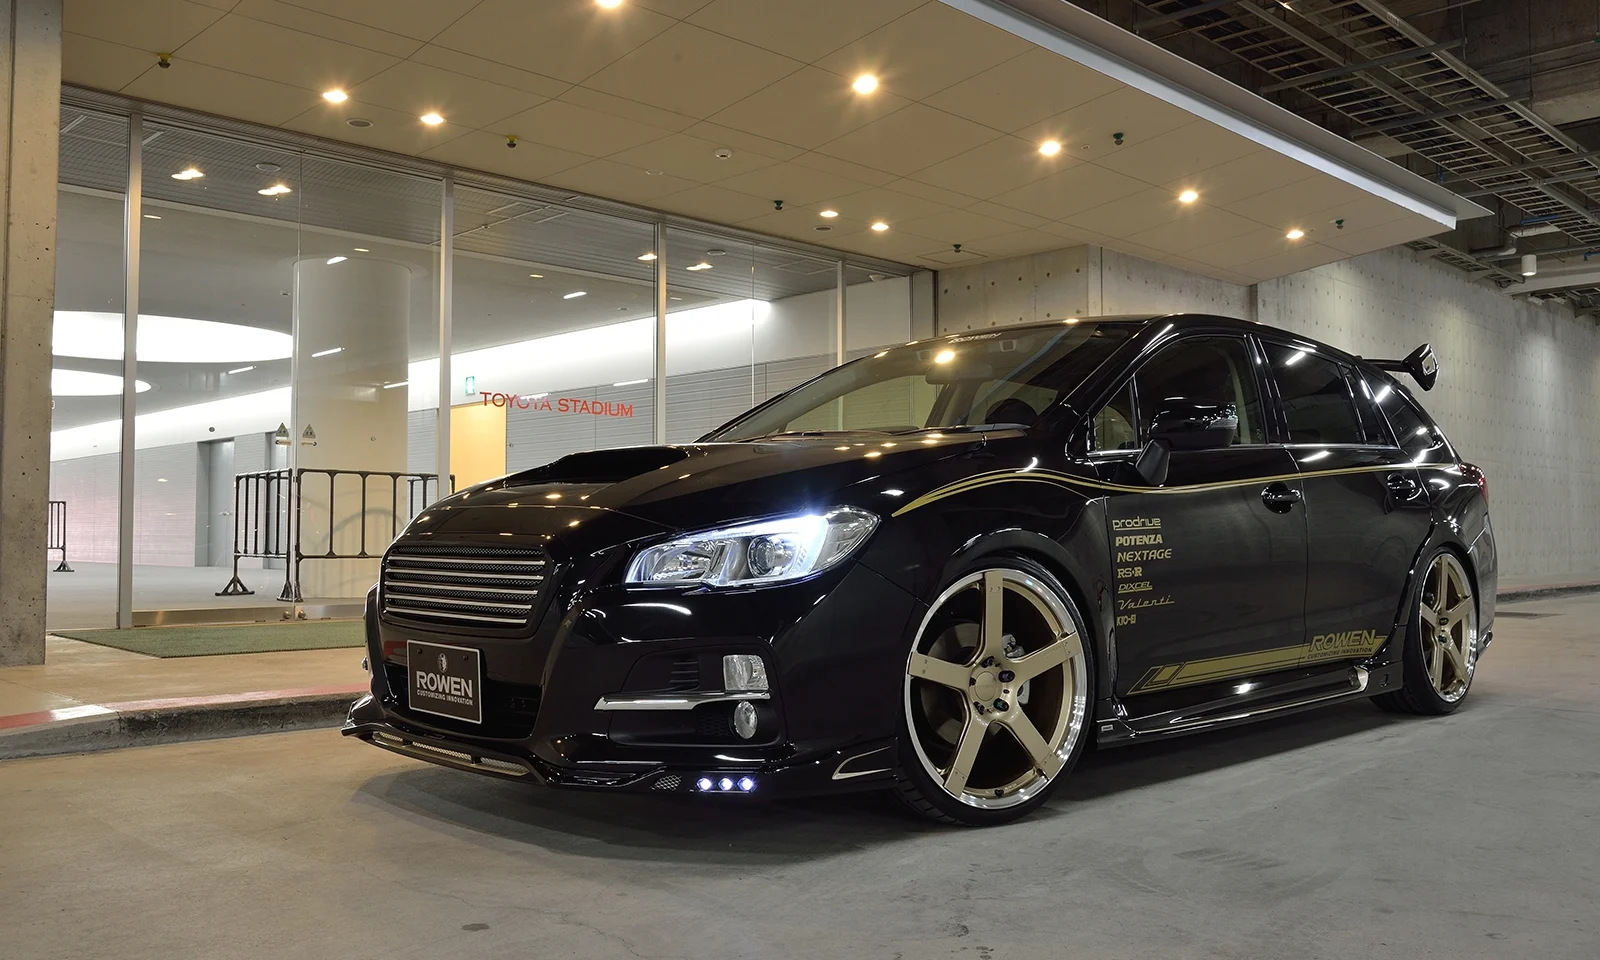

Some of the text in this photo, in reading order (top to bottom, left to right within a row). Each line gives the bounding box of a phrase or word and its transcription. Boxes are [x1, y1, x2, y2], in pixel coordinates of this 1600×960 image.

[479, 391, 634, 418] TOYOTA STADIUM
[1112, 515, 1161, 531] prodrive
[1115, 534, 1163, 547] POTENZA
[1116, 548, 1172, 563] NEXTAGE
[1117, 581, 1153, 594] DIXCEL
[1117, 594, 1175, 611] Valenti
[1309, 629, 1376, 652] ROWEN
[416, 671, 473, 698] ROWEN
